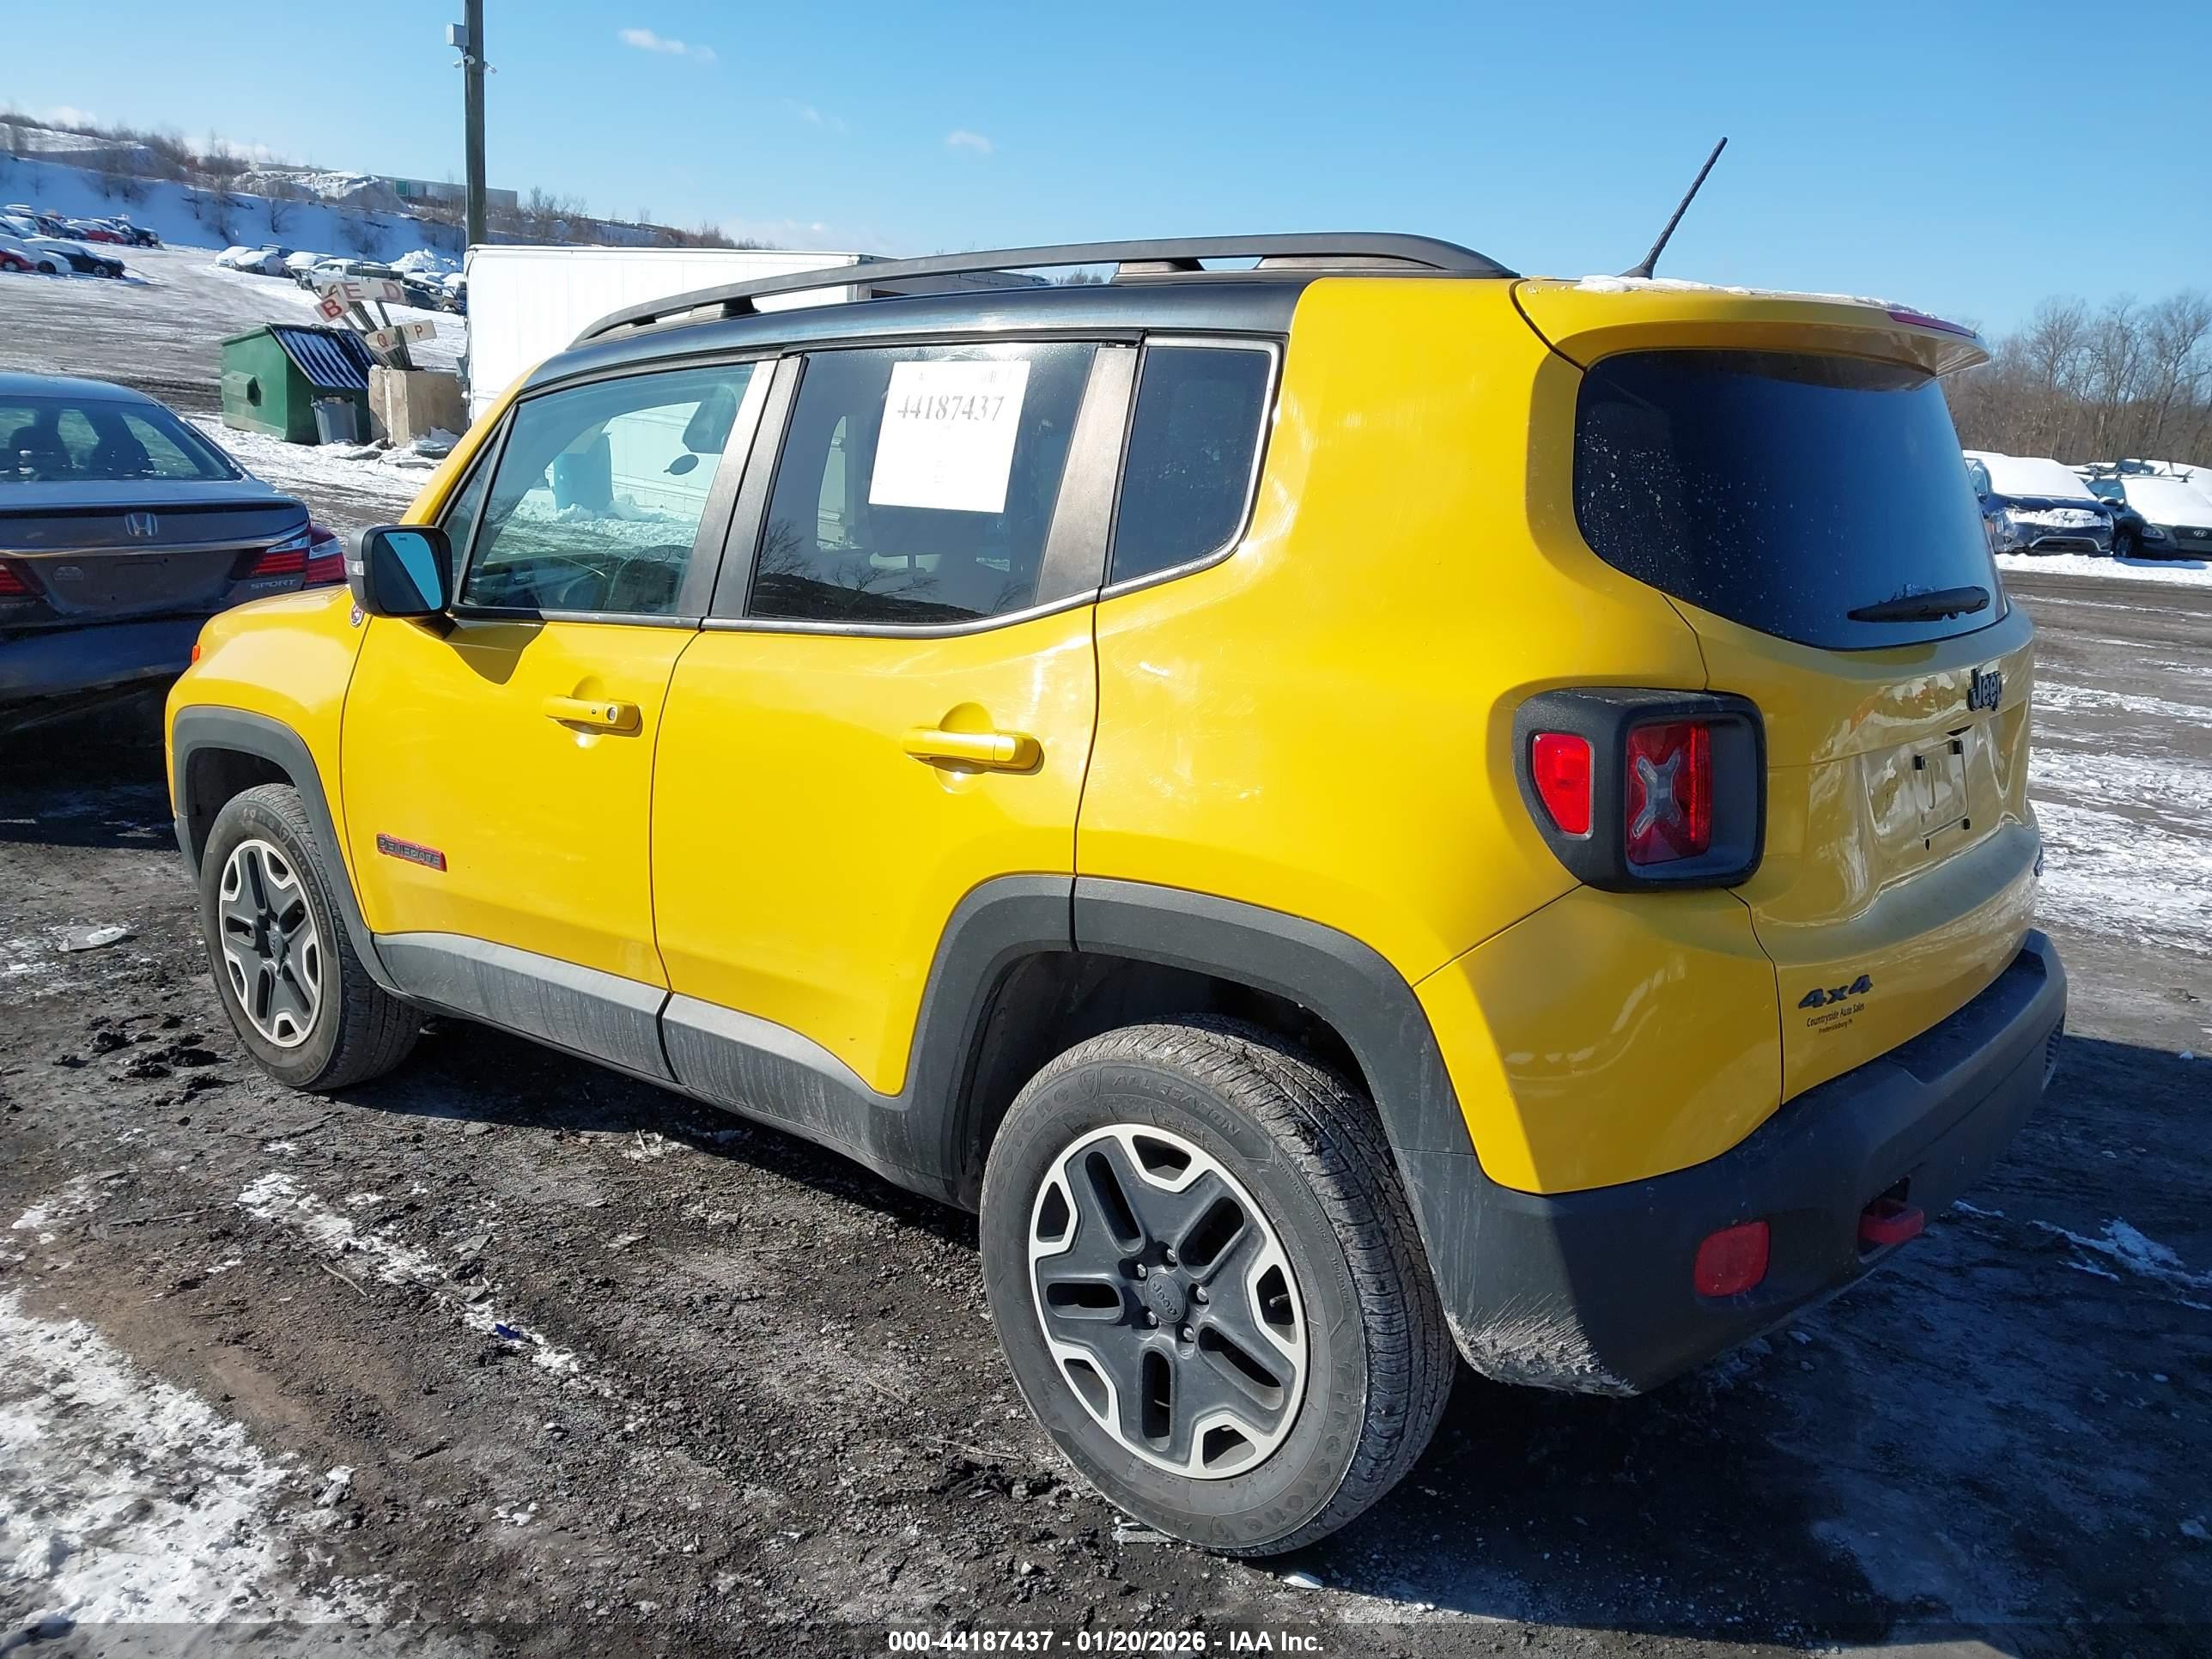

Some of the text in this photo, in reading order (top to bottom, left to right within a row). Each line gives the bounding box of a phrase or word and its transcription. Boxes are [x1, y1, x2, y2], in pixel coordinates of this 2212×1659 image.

[341, 282, 366, 300] E
[381, 282, 401, 300] D
[320, 298, 343, 318] B
[376, 332, 389, 348] Q
[414, 324, 423, 338] P
[896, 394, 1006, 422] 44187437
[250, 578, 296, 591] SPORT
[1966, 668, 2002, 712] Jeep
[1798, 974, 1874, 1009] 4x4
[1807, 1011, 1839, 1028] Countryside
[1840, 1006, 1852, 1018] Auto
[1853, 1002, 1865, 1014] Sales
[1152, 1281, 1178, 1316] Jeep
